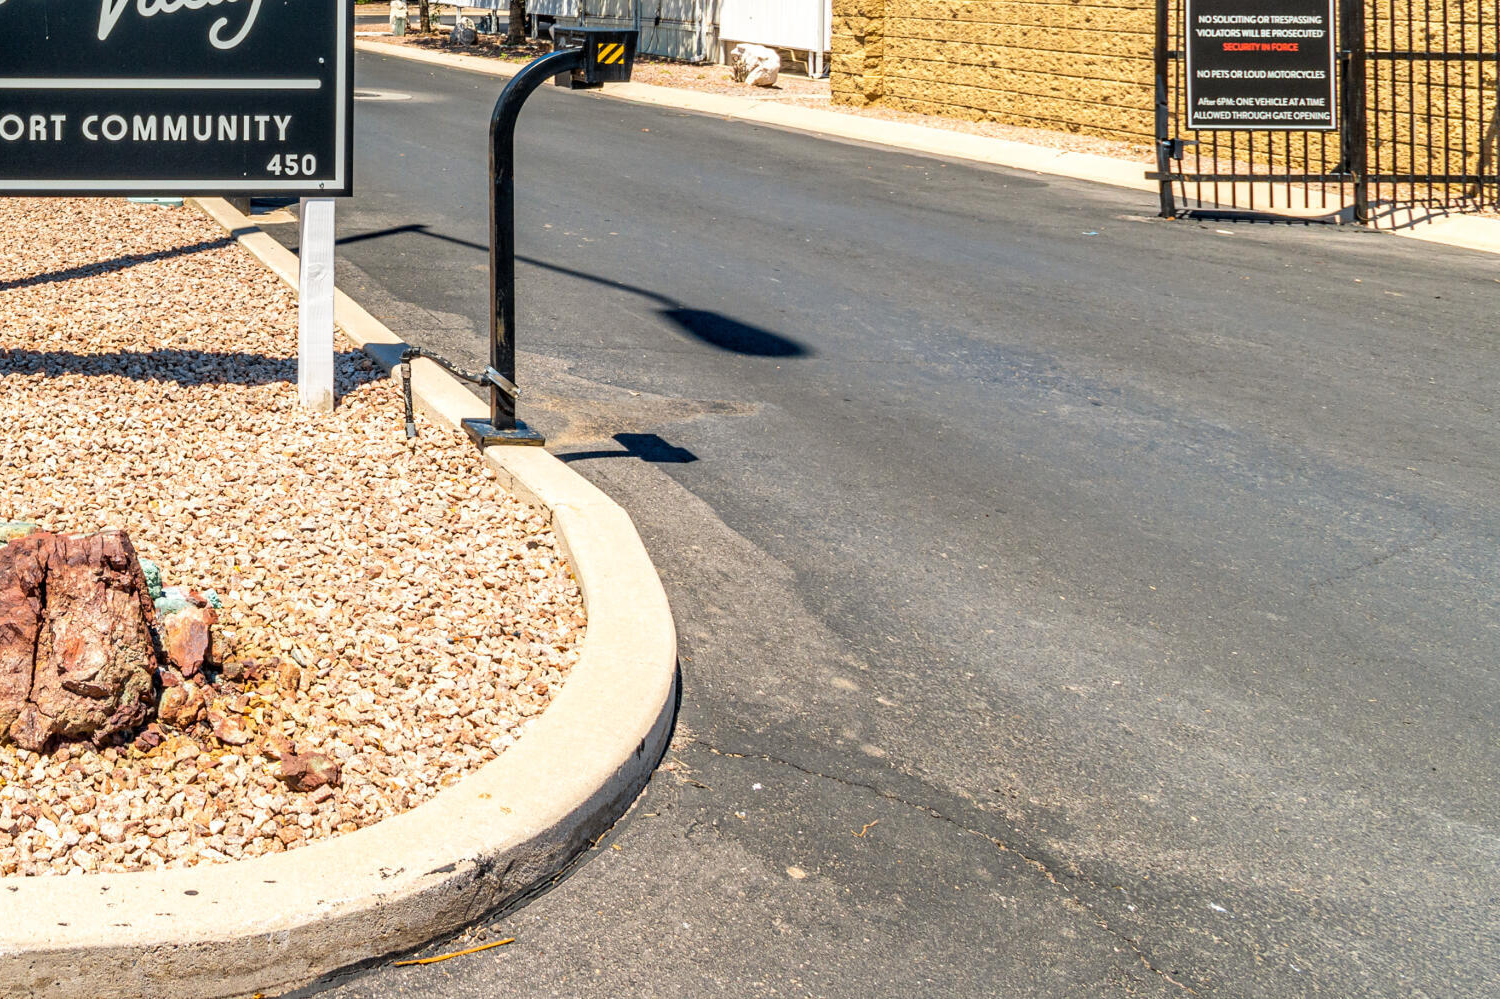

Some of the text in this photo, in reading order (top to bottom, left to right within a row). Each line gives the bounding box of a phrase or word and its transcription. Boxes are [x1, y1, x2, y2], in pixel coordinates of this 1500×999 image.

[1198, 15, 1323, 25] NO SOLICITING OR TRESPASSING
[1241, 29, 1260, 37] WILL
[1260, 29, 1272, 37] BE
[1222, 42, 1299, 52] SECURITY IN FORCE
[1196, 70, 1326, 80] NO PETS OR LOUD MOTORCYCLES
[1197, 97, 1216, 106] After
[1235, 97, 1255, 106] ONE
[1255, 97, 1289, 107] VEHICLE
[1288, 97, 1299, 106] AT
[1298, 97, 1306, 106] A
[1306, 97, 1326, 107] TIME
[1192, 111, 1331, 120] ALLOWED THROUGH GATE OPENING
[82, 114, 293, 142] COMMUNITY
[266, 153, 317, 177] 450
